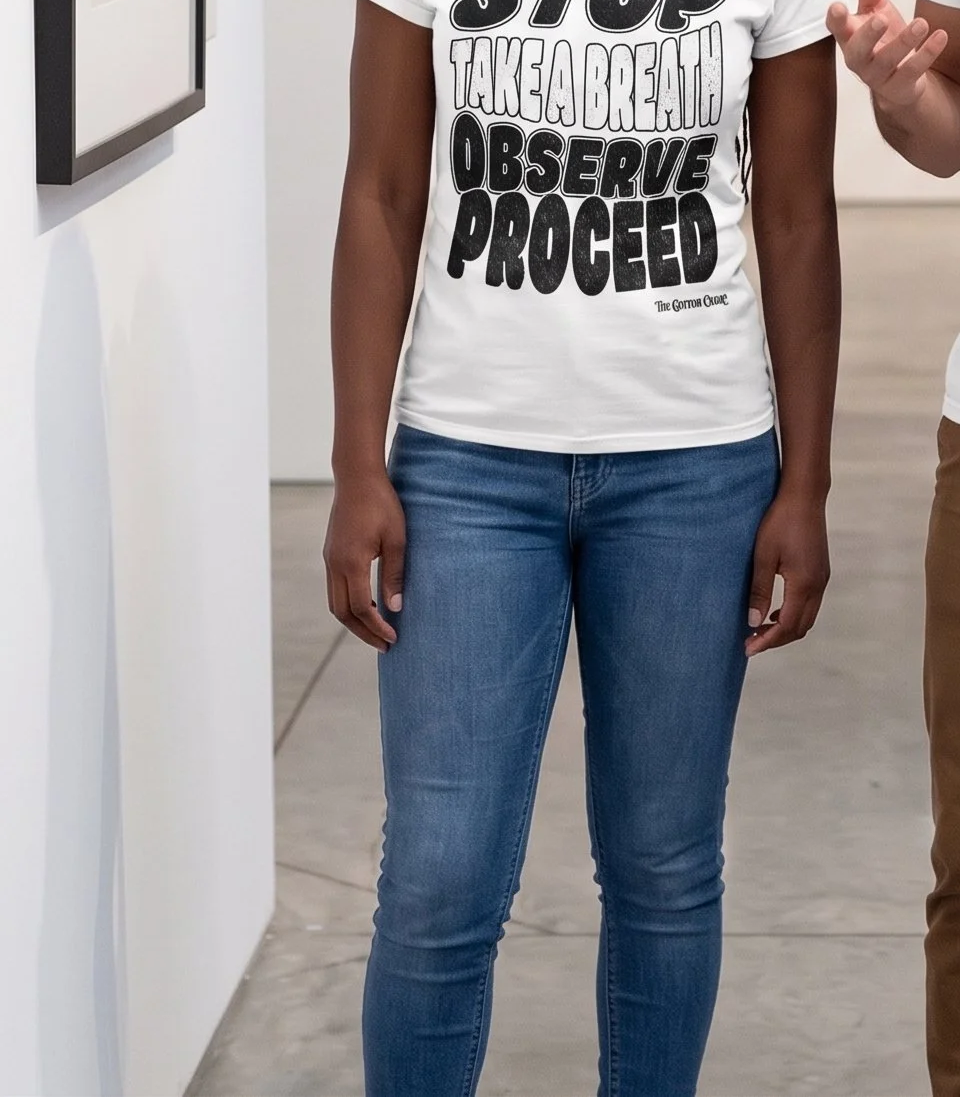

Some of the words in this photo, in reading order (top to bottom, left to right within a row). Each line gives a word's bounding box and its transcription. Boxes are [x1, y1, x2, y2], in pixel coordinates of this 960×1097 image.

[450, 36, 544, 123] TAKE
[546, 40, 576, 127] A
[583, 21, 723, 132] BREATH
[450, 111, 718, 199] OBSERVE
[447, 188, 718, 296] PROCEED
